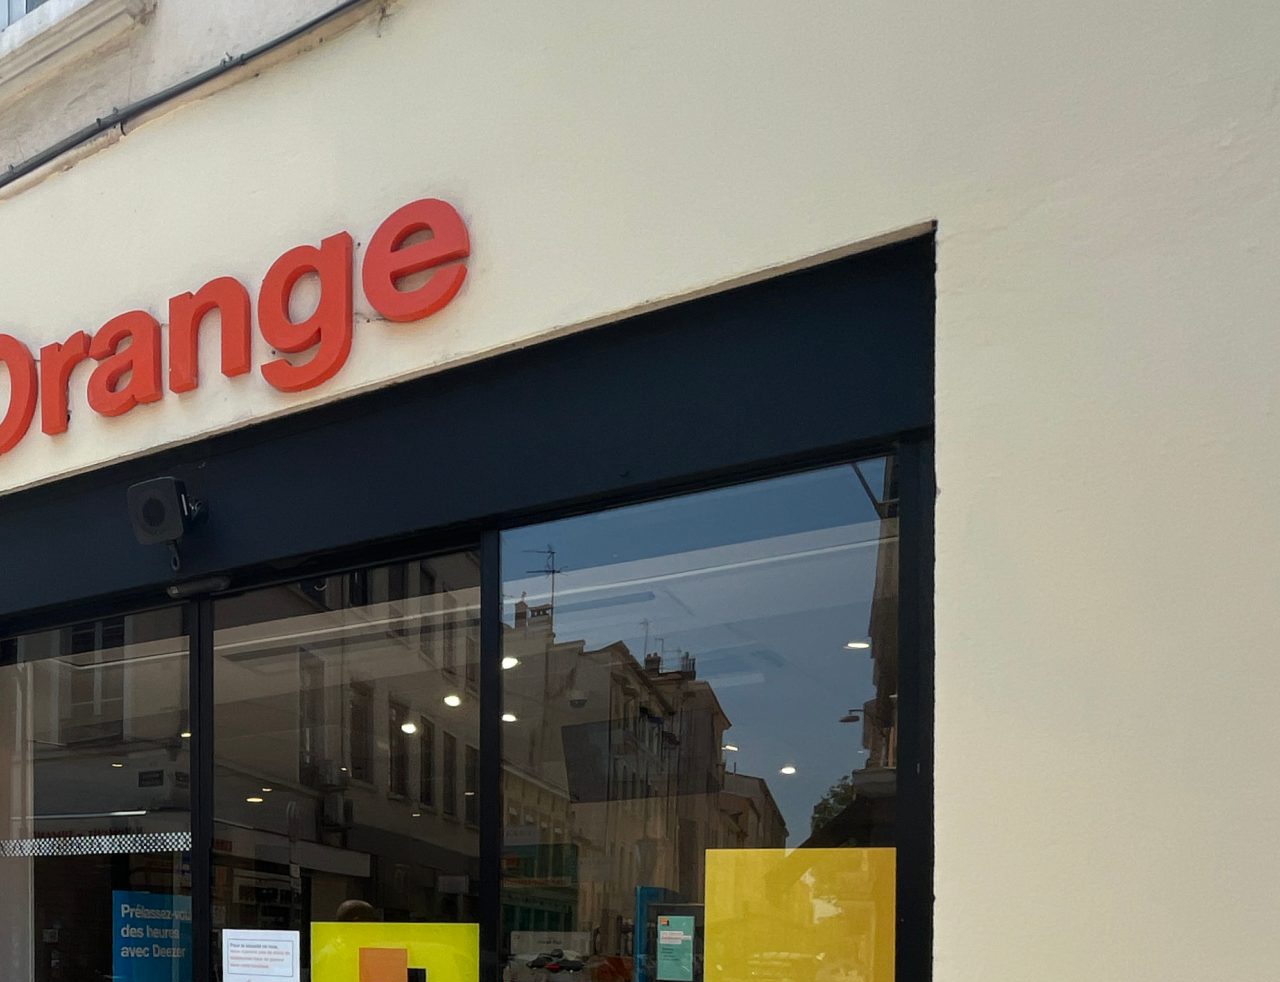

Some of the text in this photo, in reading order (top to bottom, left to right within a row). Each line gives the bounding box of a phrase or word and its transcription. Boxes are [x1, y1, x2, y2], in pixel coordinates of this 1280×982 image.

[120, 923, 180, 939] des heures
[120, 944, 186, 958] avec Deezer
